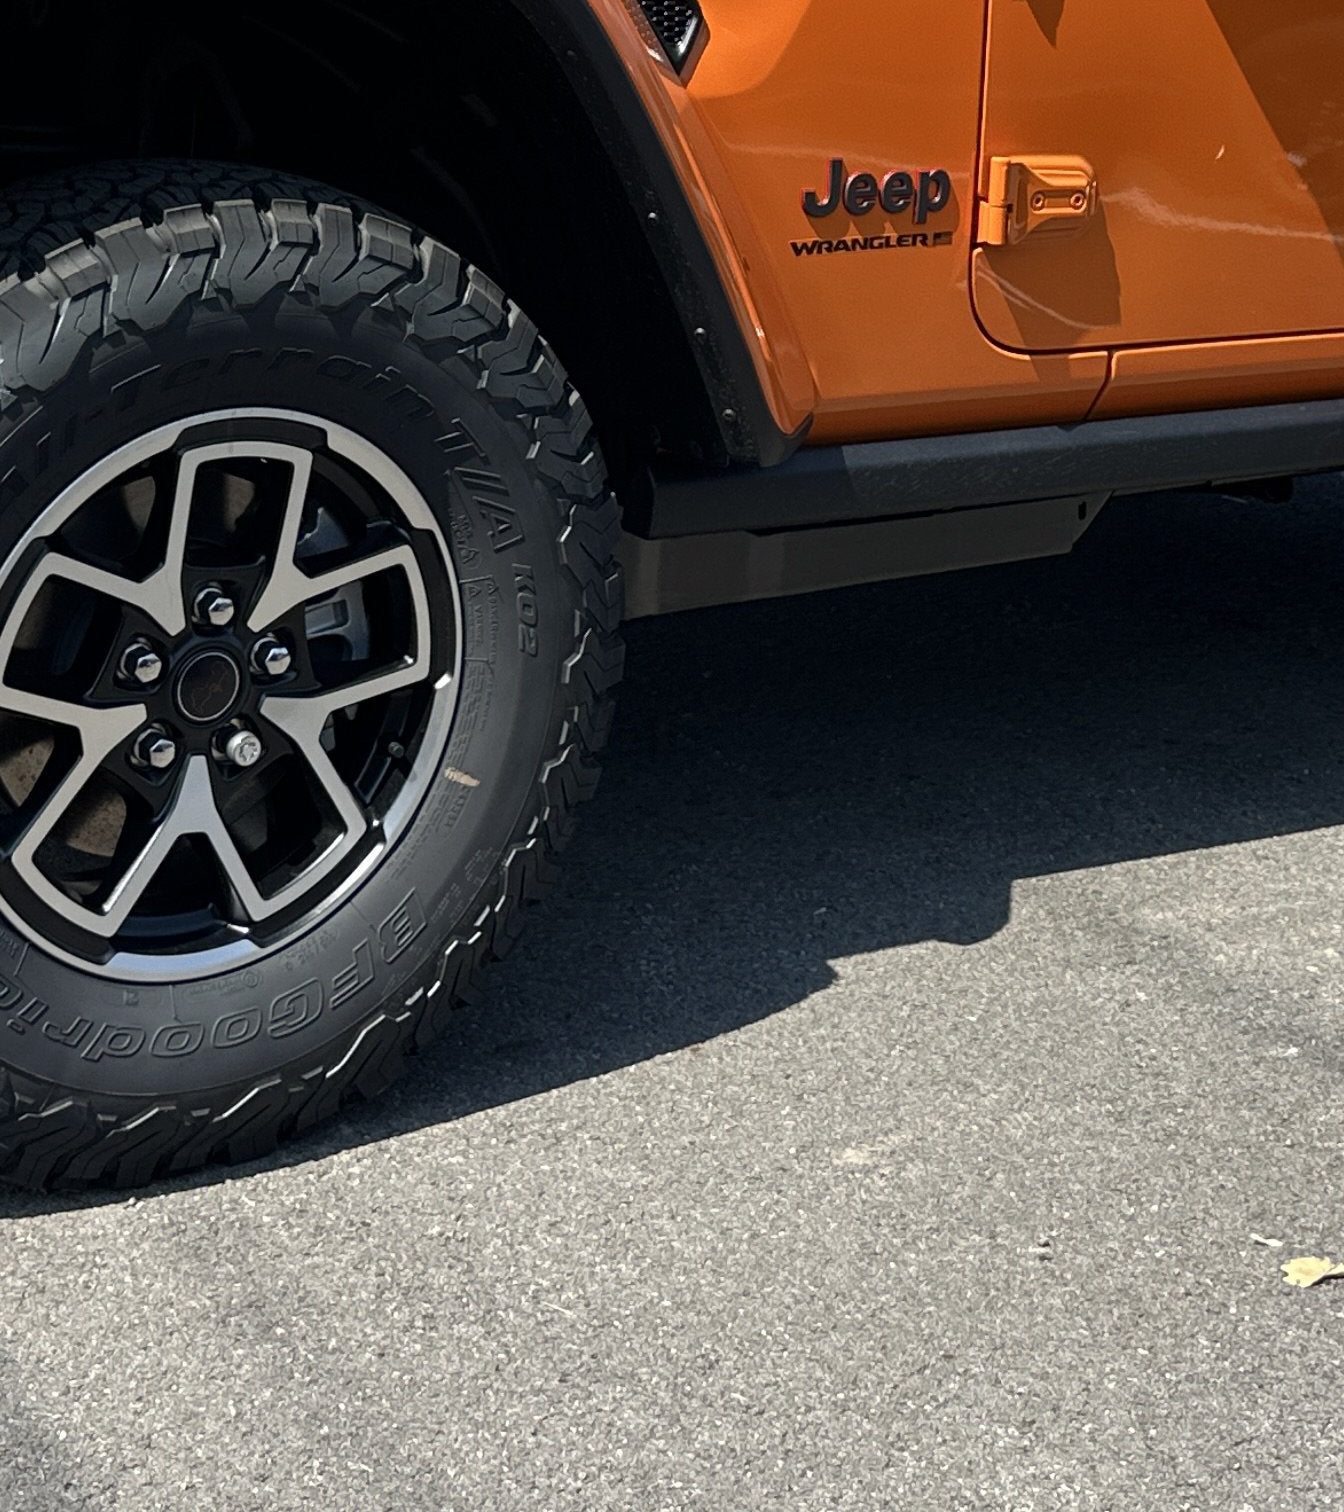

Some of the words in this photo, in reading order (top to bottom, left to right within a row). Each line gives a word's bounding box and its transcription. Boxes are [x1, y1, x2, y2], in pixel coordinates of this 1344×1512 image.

[802, 158, 951, 225] Jeep
[790, 233, 928, 257] WRANGLER
[511, 562, 540, 657] KO2
